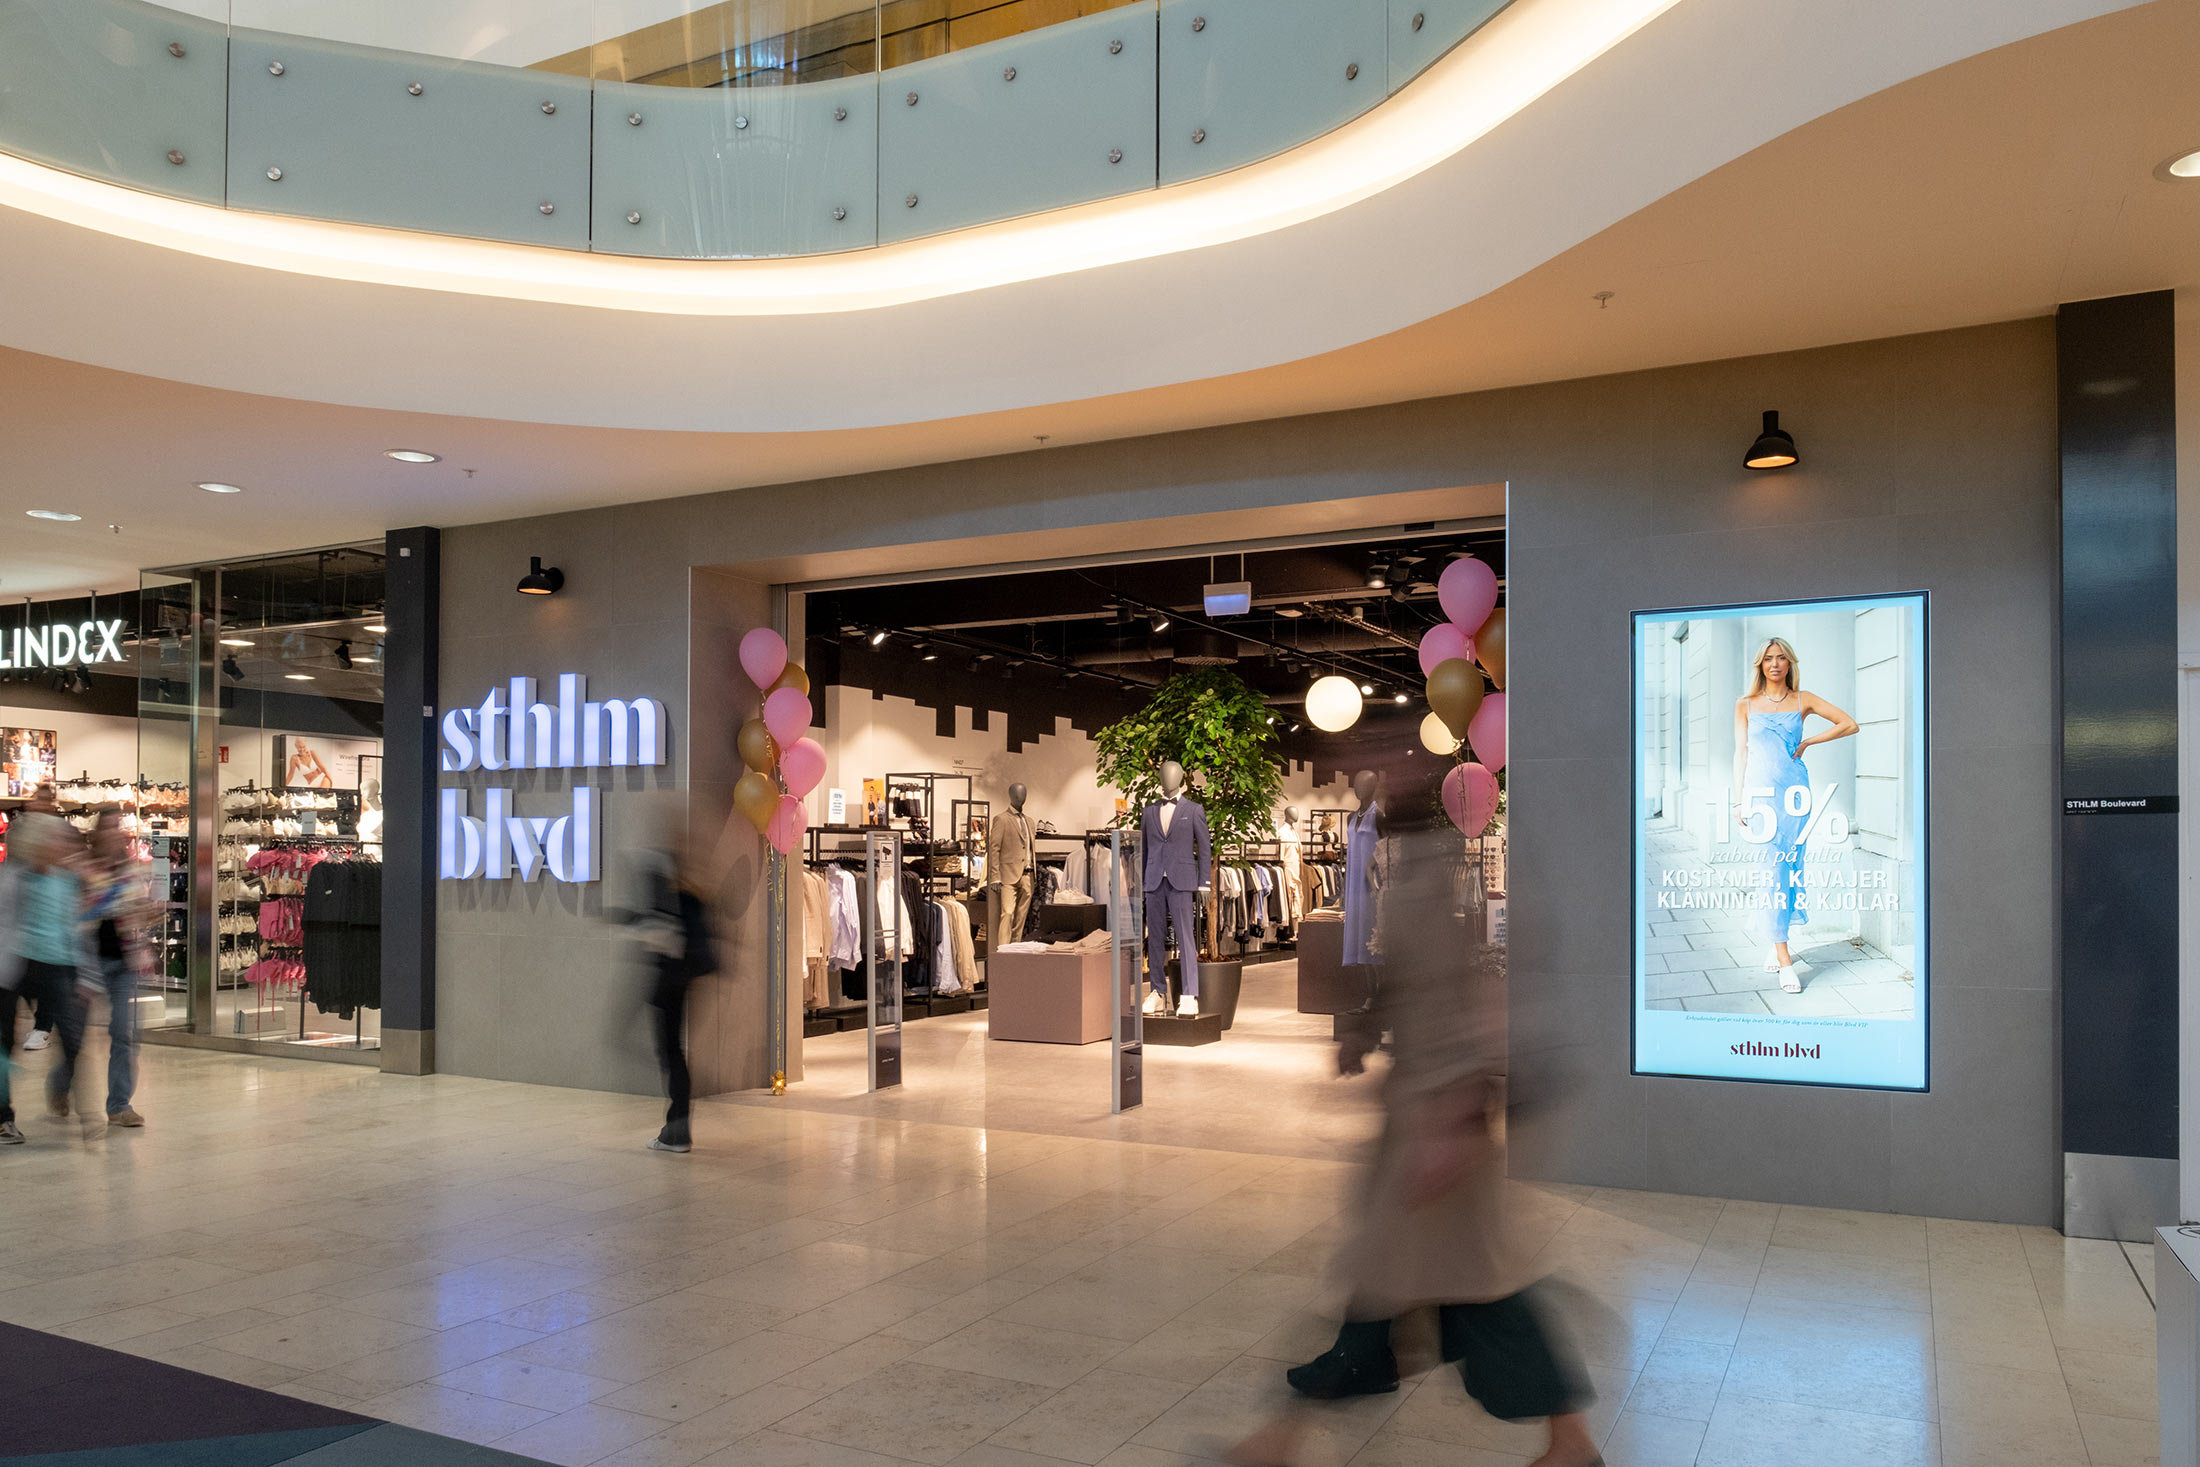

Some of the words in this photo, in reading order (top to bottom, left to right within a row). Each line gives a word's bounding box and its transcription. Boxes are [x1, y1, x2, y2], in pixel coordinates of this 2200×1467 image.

[0, 619, 122, 668] LINDEX
[441, 672, 665, 772] sthlm
[1705, 783, 1851, 846] 15%
[2066, 800, 2098, 809] STHLM
[2100, 799, 2146, 808] Boulevard
[441, 786, 600, 883] blvd
[1709, 847, 1769, 864] rabatt
[1772, 845, 1799, 867] på
[1803, 847, 1843, 864] alla
[1662, 869, 1781, 891] KOSTYMER,
[1789, 870, 1887, 889] KAVAJER
[1657, 888, 1787, 911] KLÄNNINGAR
[1794, 892, 1810, 911] &
[1816, 892, 1900, 912] KJOLAR
[1730, 1040, 1779, 1057] sthlm
[1784, 1042, 1820, 1059] blvd
